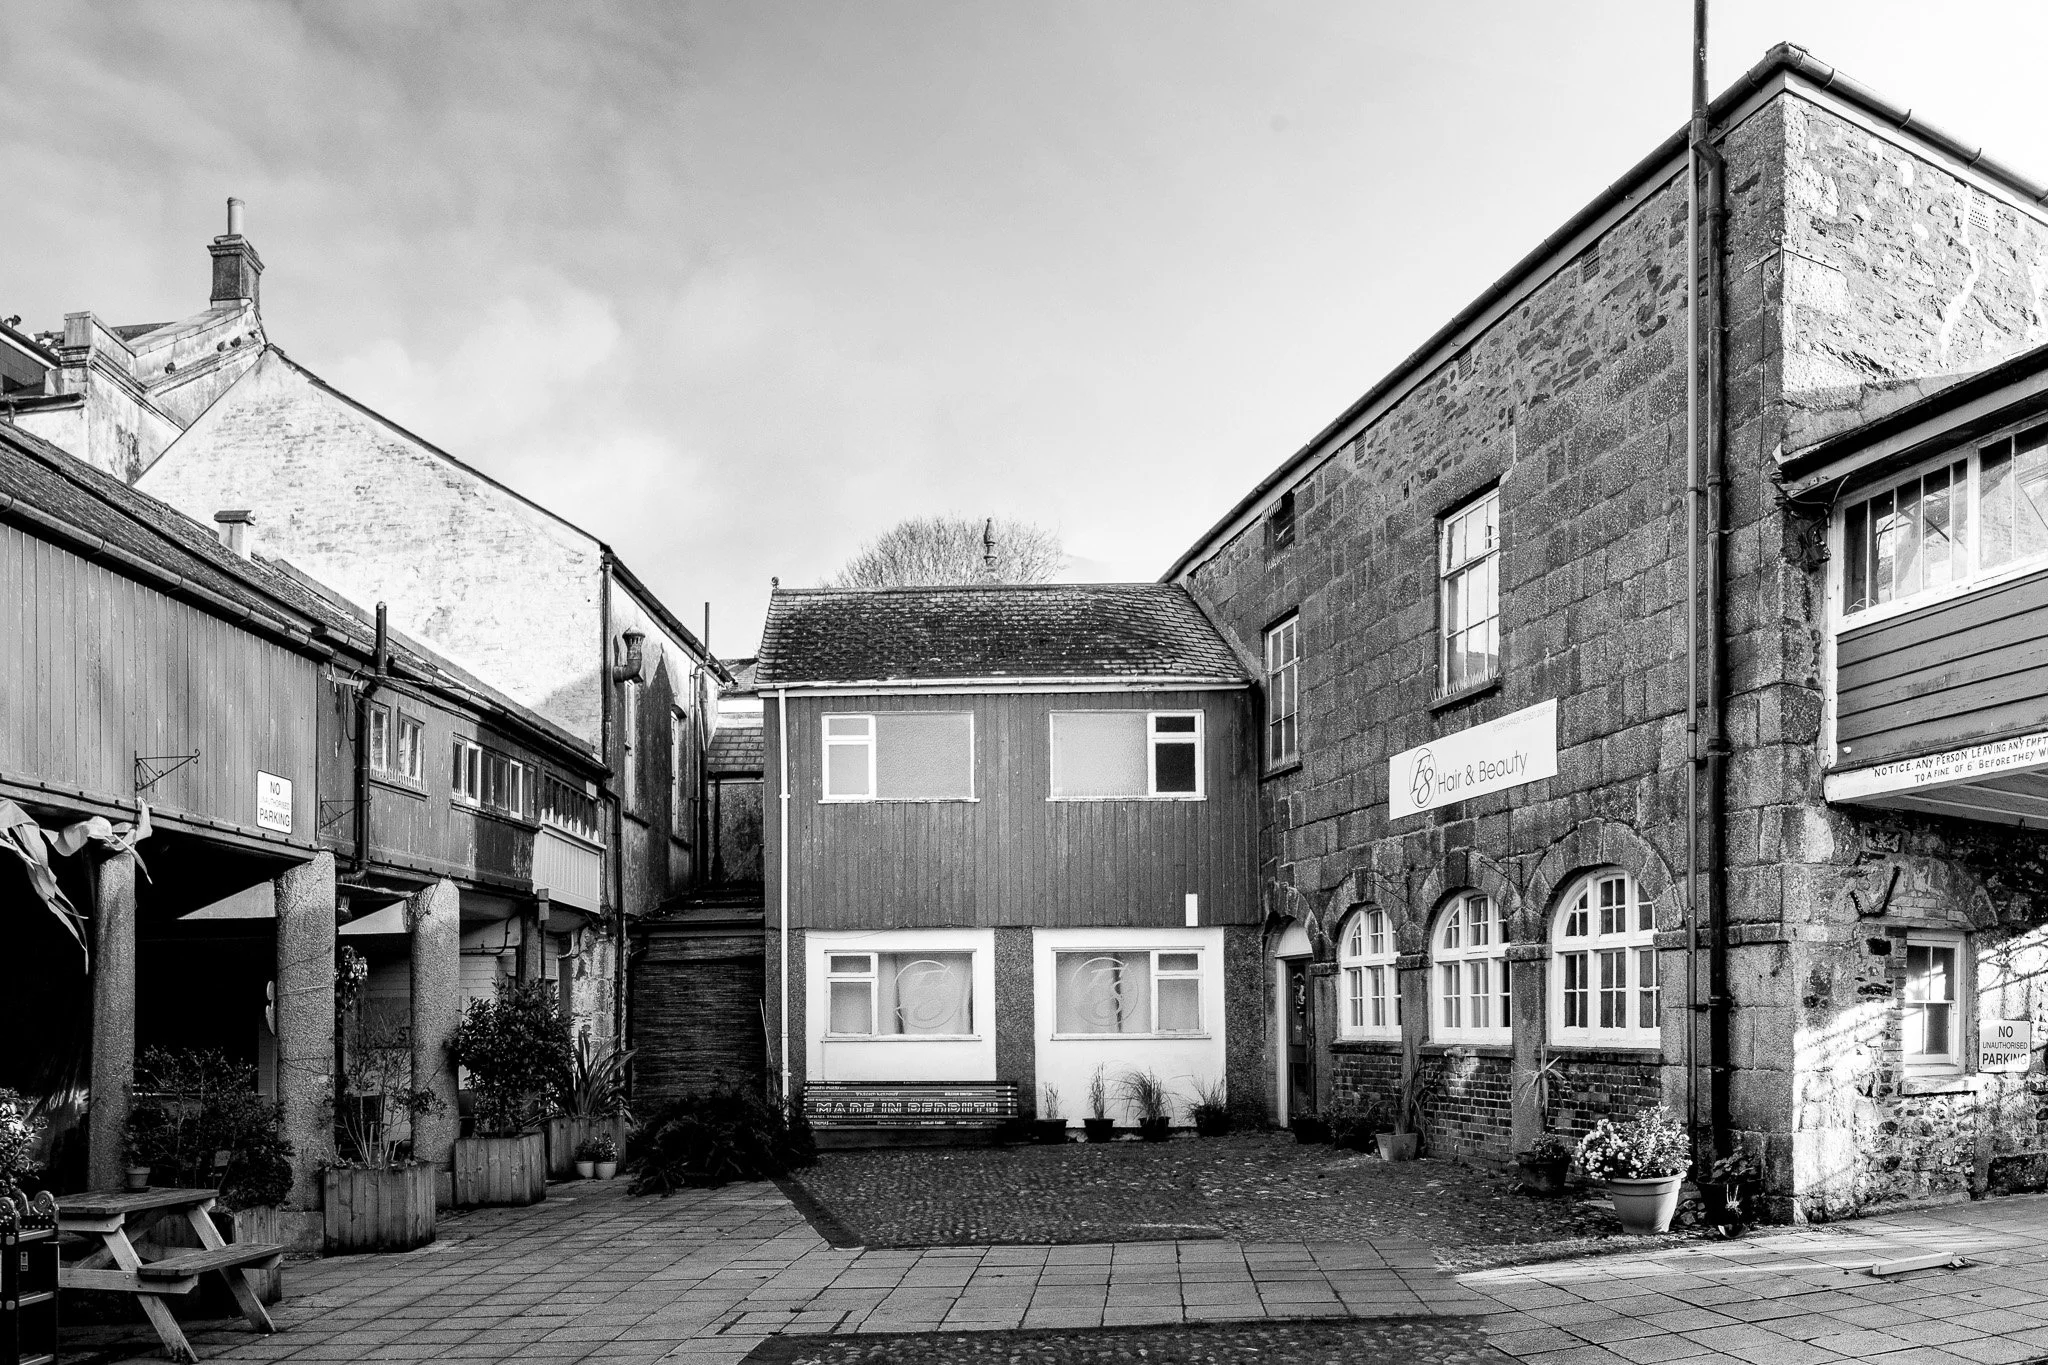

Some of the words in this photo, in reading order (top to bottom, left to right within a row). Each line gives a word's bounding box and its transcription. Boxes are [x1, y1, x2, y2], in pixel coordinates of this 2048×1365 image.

[1916, 758, 1934, 770] ANY
[1936, 750, 1968, 767] PERSON
[1971, 742, 2007, 759] LEAVING
[2008, 737, 2025, 751] ANY
[1438, 769, 1462, 794] Hair
[1465, 764, 1475, 786] &
[1479, 750, 1528, 782] Beauty
[1914, 773, 1926, 784] TO
[1926, 771, 1933, 780] A
[1934, 767, 1950, 778] FINE
[1954, 764, 1964, 774] OF
[1978, 756, 2011, 770] BEFORE
[2012, 750, 2036, 763] THEY
[270, 781, 281, 796] NO
[260, 807, 290, 827] PARKING
[1998, 1025, 2014, 1038] NO
[1982, 1041, 2028, 1050] UNAUTHORISED
[1982, 1052, 2027, 1065] PARKING
[816, 1102, 876, 1113] MADE
[881, 1102, 902, 1113] IN
